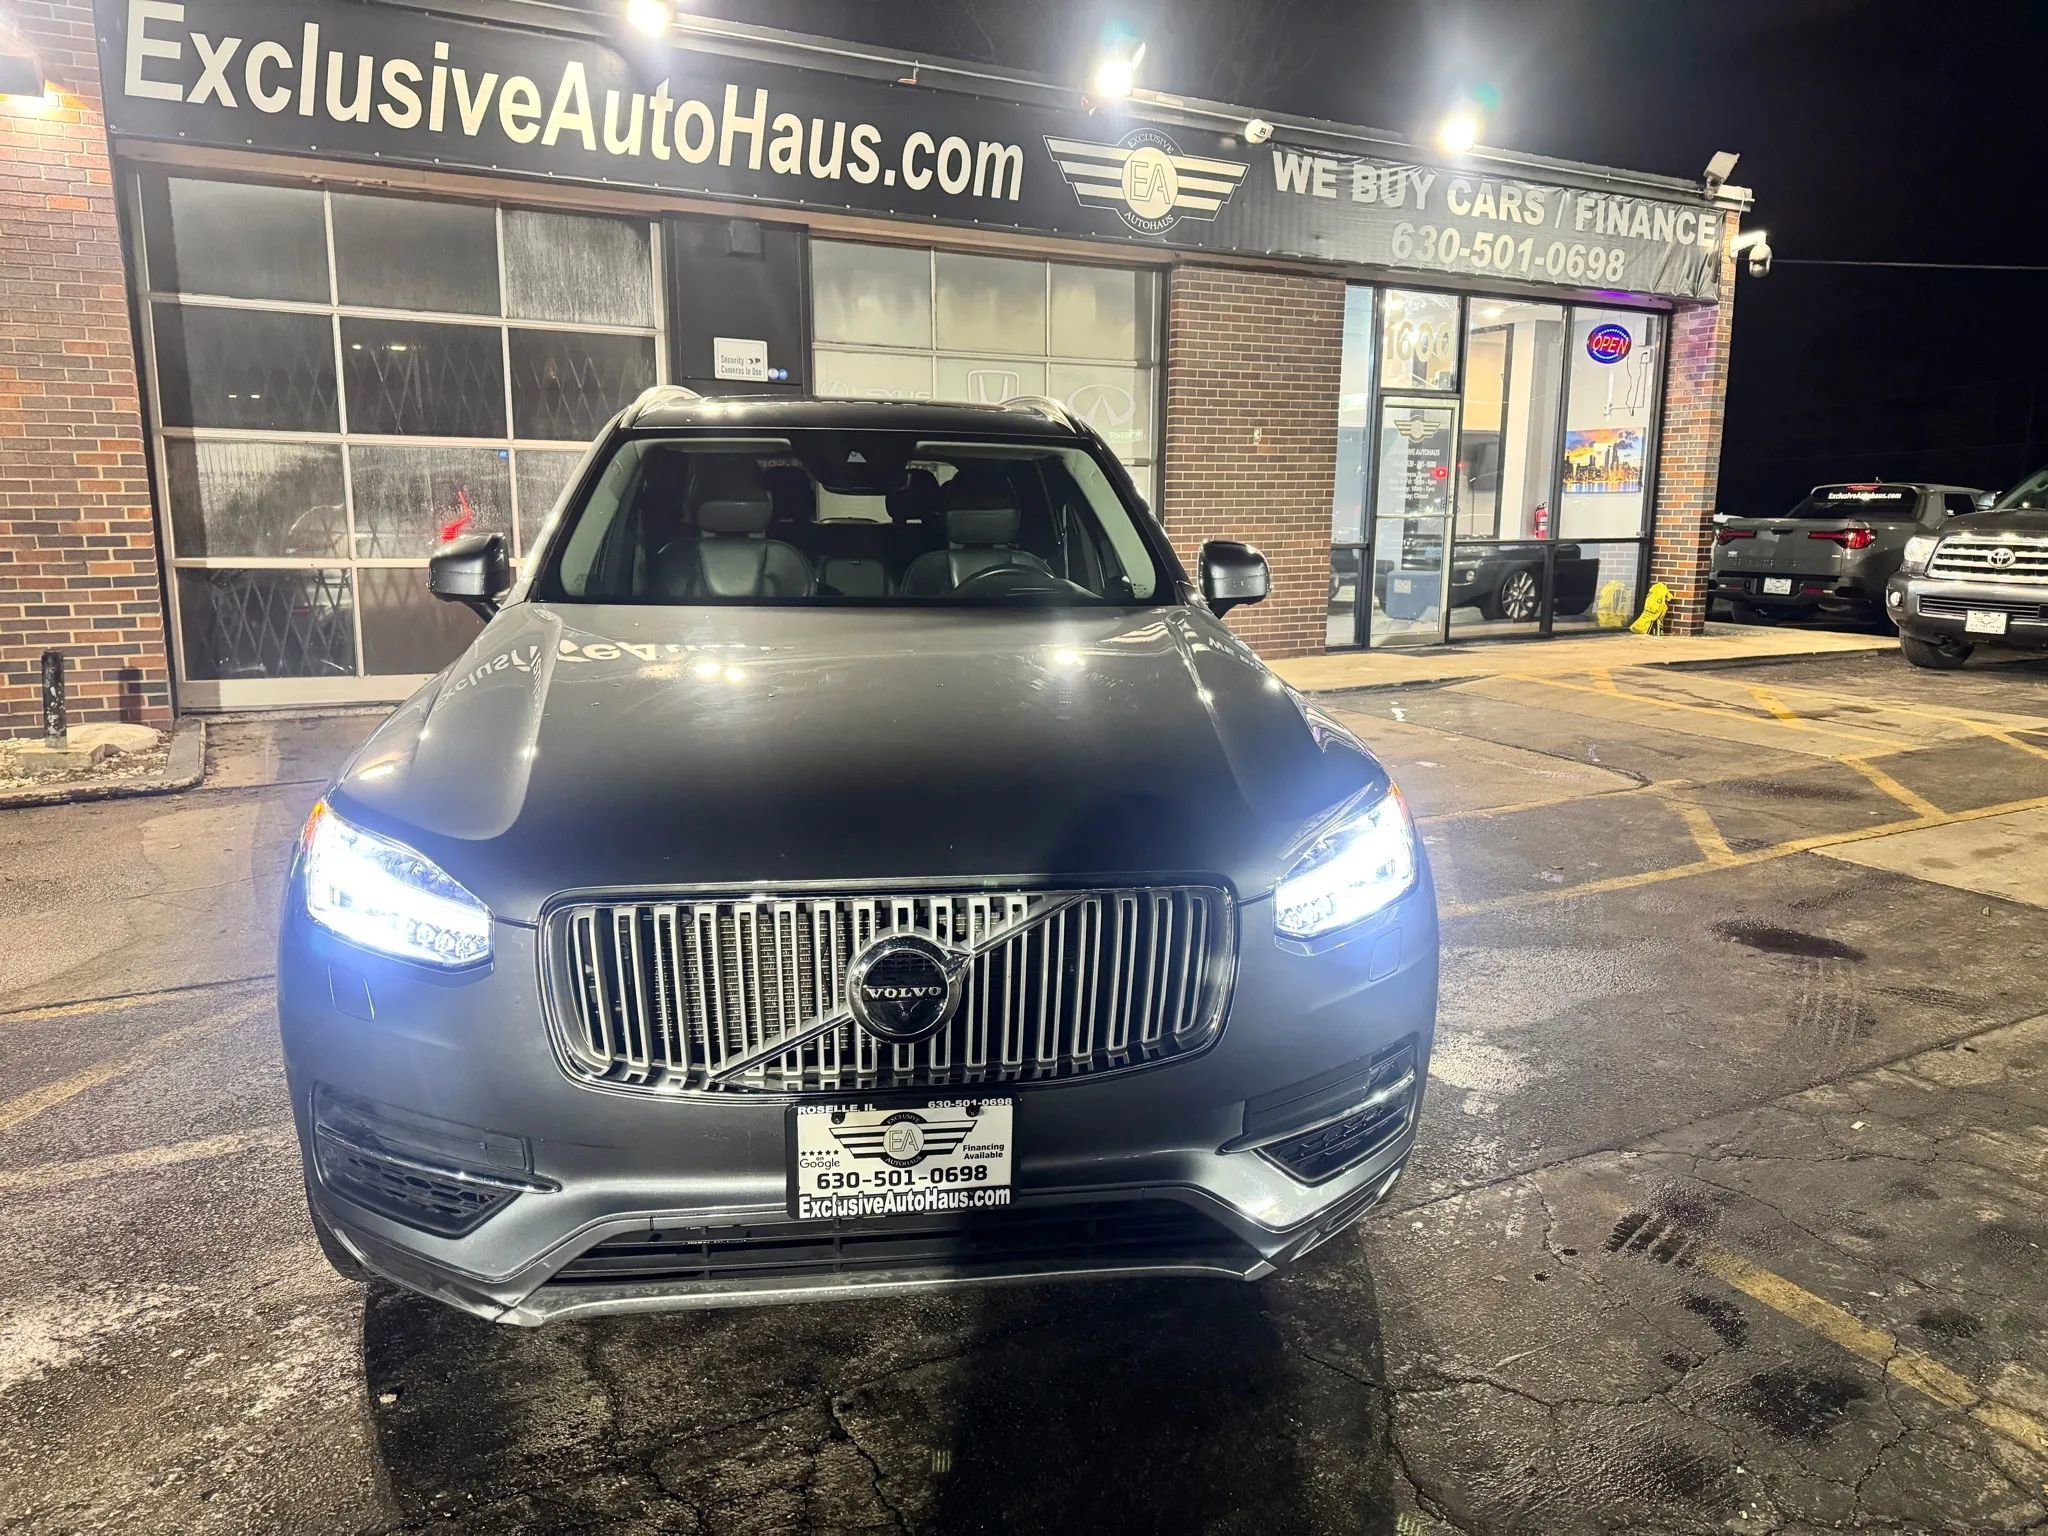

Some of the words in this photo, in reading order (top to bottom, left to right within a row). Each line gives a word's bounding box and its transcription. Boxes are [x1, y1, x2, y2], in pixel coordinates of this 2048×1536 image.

[123, 0, 1025, 201] ExclusiveAutoHaus.com
[1127, 133, 1175, 154] EXCLUSIVE
[1129, 160, 1171, 205] EA
[1271, 150, 1338, 199] WE
[1351, 164, 1436, 210] BUY
[1446, 177, 1546, 227] CARS
[1574, 196, 1718, 248] FINANCE
[1124, 214, 1175, 231] AUTOHAUS
[1390, 221, 1627, 283] 630-501-0698
[1384, 321, 1455, 362] 1600
[1592, 335, 1629, 354] OPEN
[867, 986, 942, 999] VOLVO
[864, 1103, 877, 1112] IL
[927, 1097, 1013, 1108] 630-501-0698
[889, 1128, 920, 1152] EA
[962, 1142, 1005, 1152] Financing
[799, 1157, 841, 1170] Google
[885, 1155, 922, 1167] AUTOHAUS
[963, 1151, 1004, 1160] Available
[816, 1164, 988, 1190] 630-501-0698
[799, 1186, 1011, 1219] ExclusiveAutoHaus.com
